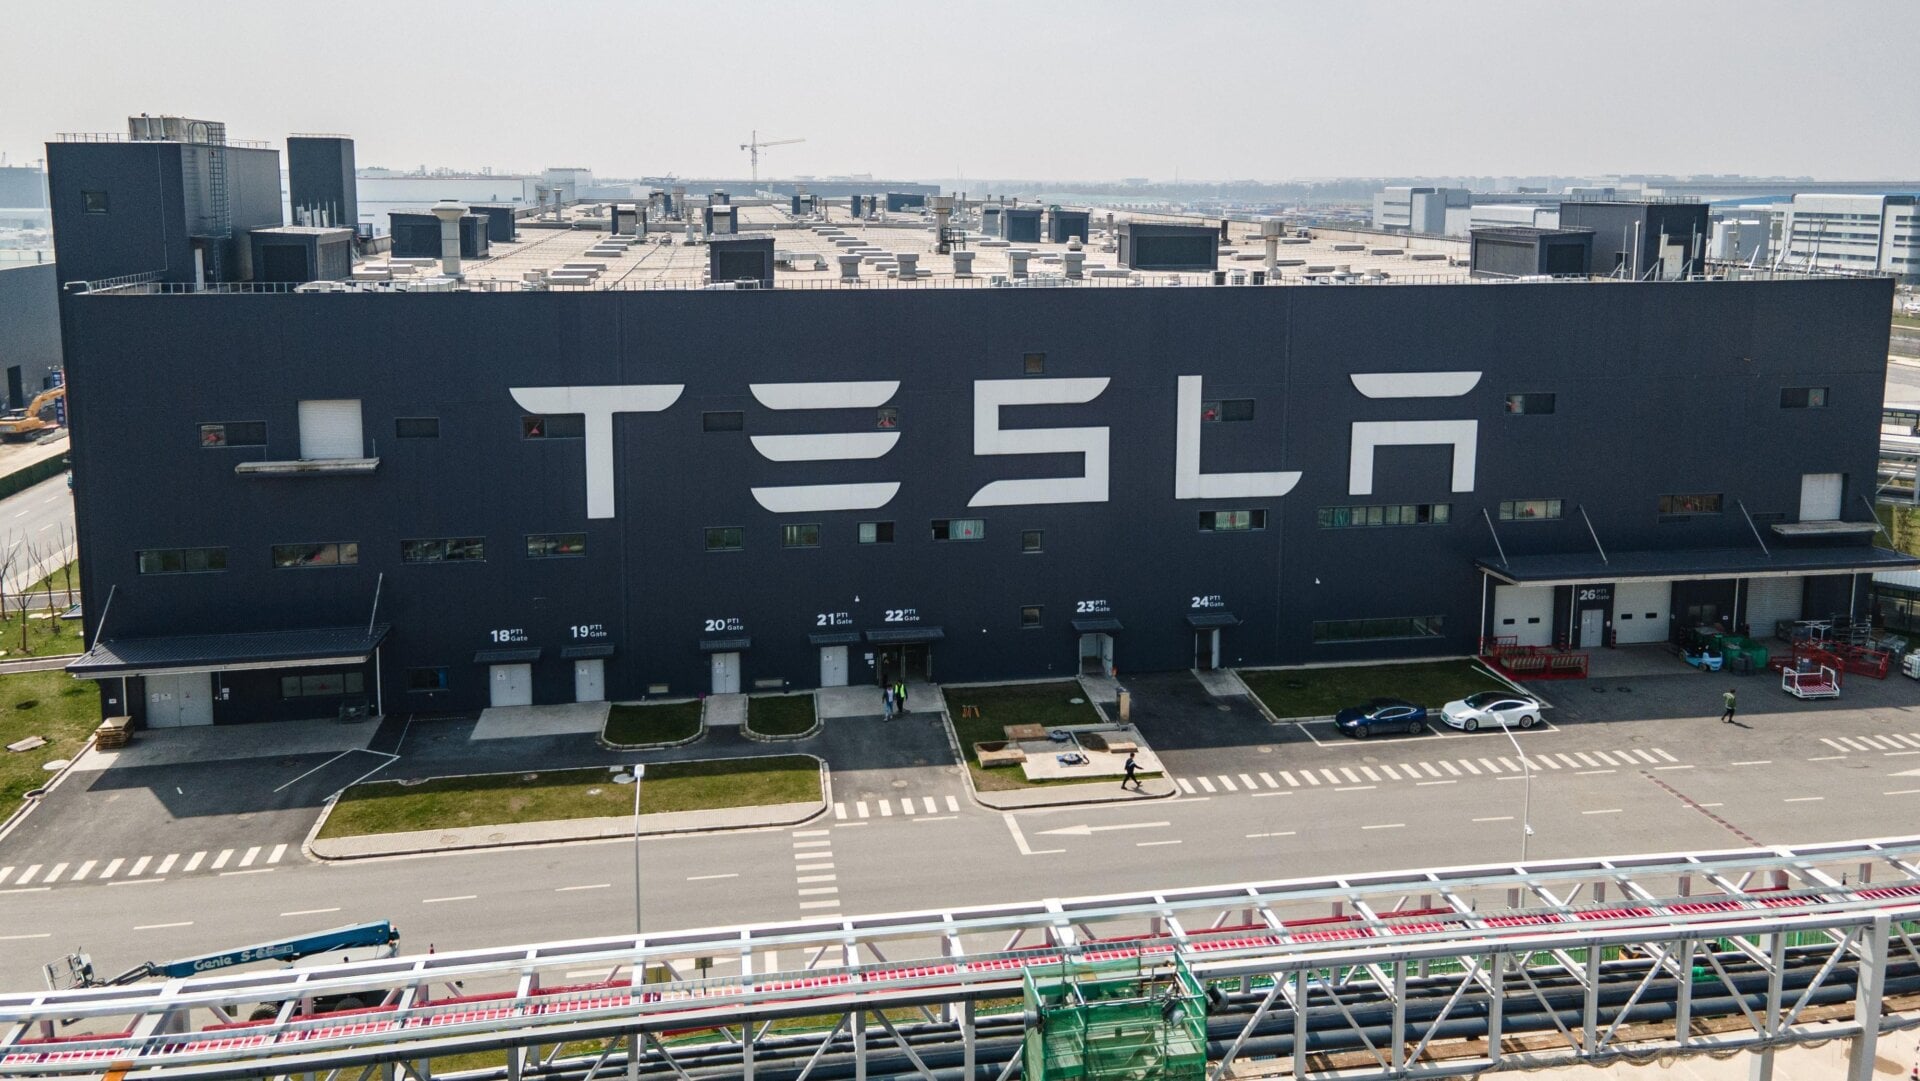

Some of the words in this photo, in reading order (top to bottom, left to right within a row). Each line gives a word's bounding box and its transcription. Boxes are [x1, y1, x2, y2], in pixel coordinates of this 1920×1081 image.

[510, 371, 1483, 519] TESLA
[1579, 590, 1596, 600] 26
[1076, 600, 1095, 613] 23
[1191, 596, 1210, 608] 24
[816, 613, 835, 626] 21
[884, 609, 904, 622] 22
[570, 625, 589, 639] 19
[704, 619, 726, 632] 20
[490, 629, 511, 643] 18
[194, 956, 233, 971] Genie
